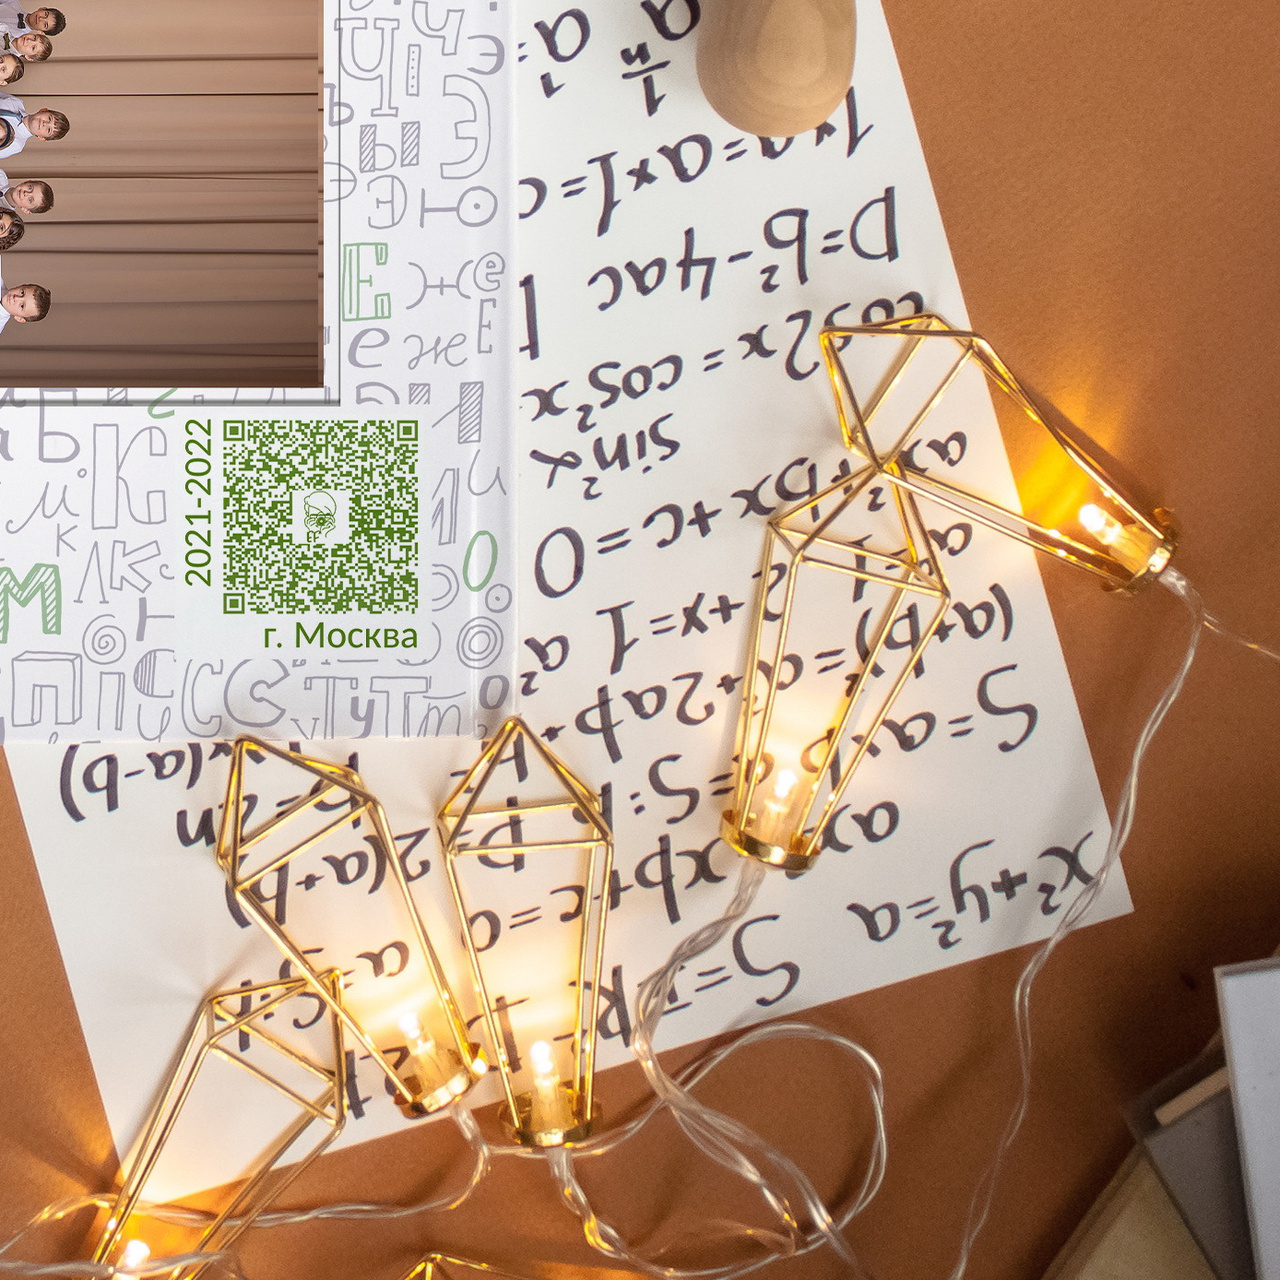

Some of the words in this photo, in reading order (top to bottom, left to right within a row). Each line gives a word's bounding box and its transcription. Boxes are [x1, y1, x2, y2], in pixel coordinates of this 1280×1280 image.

[184, 418, 212, 587] 2021-2022
[263, 628, 283, 649] г.
[295, 621, 419, 649] Москва
